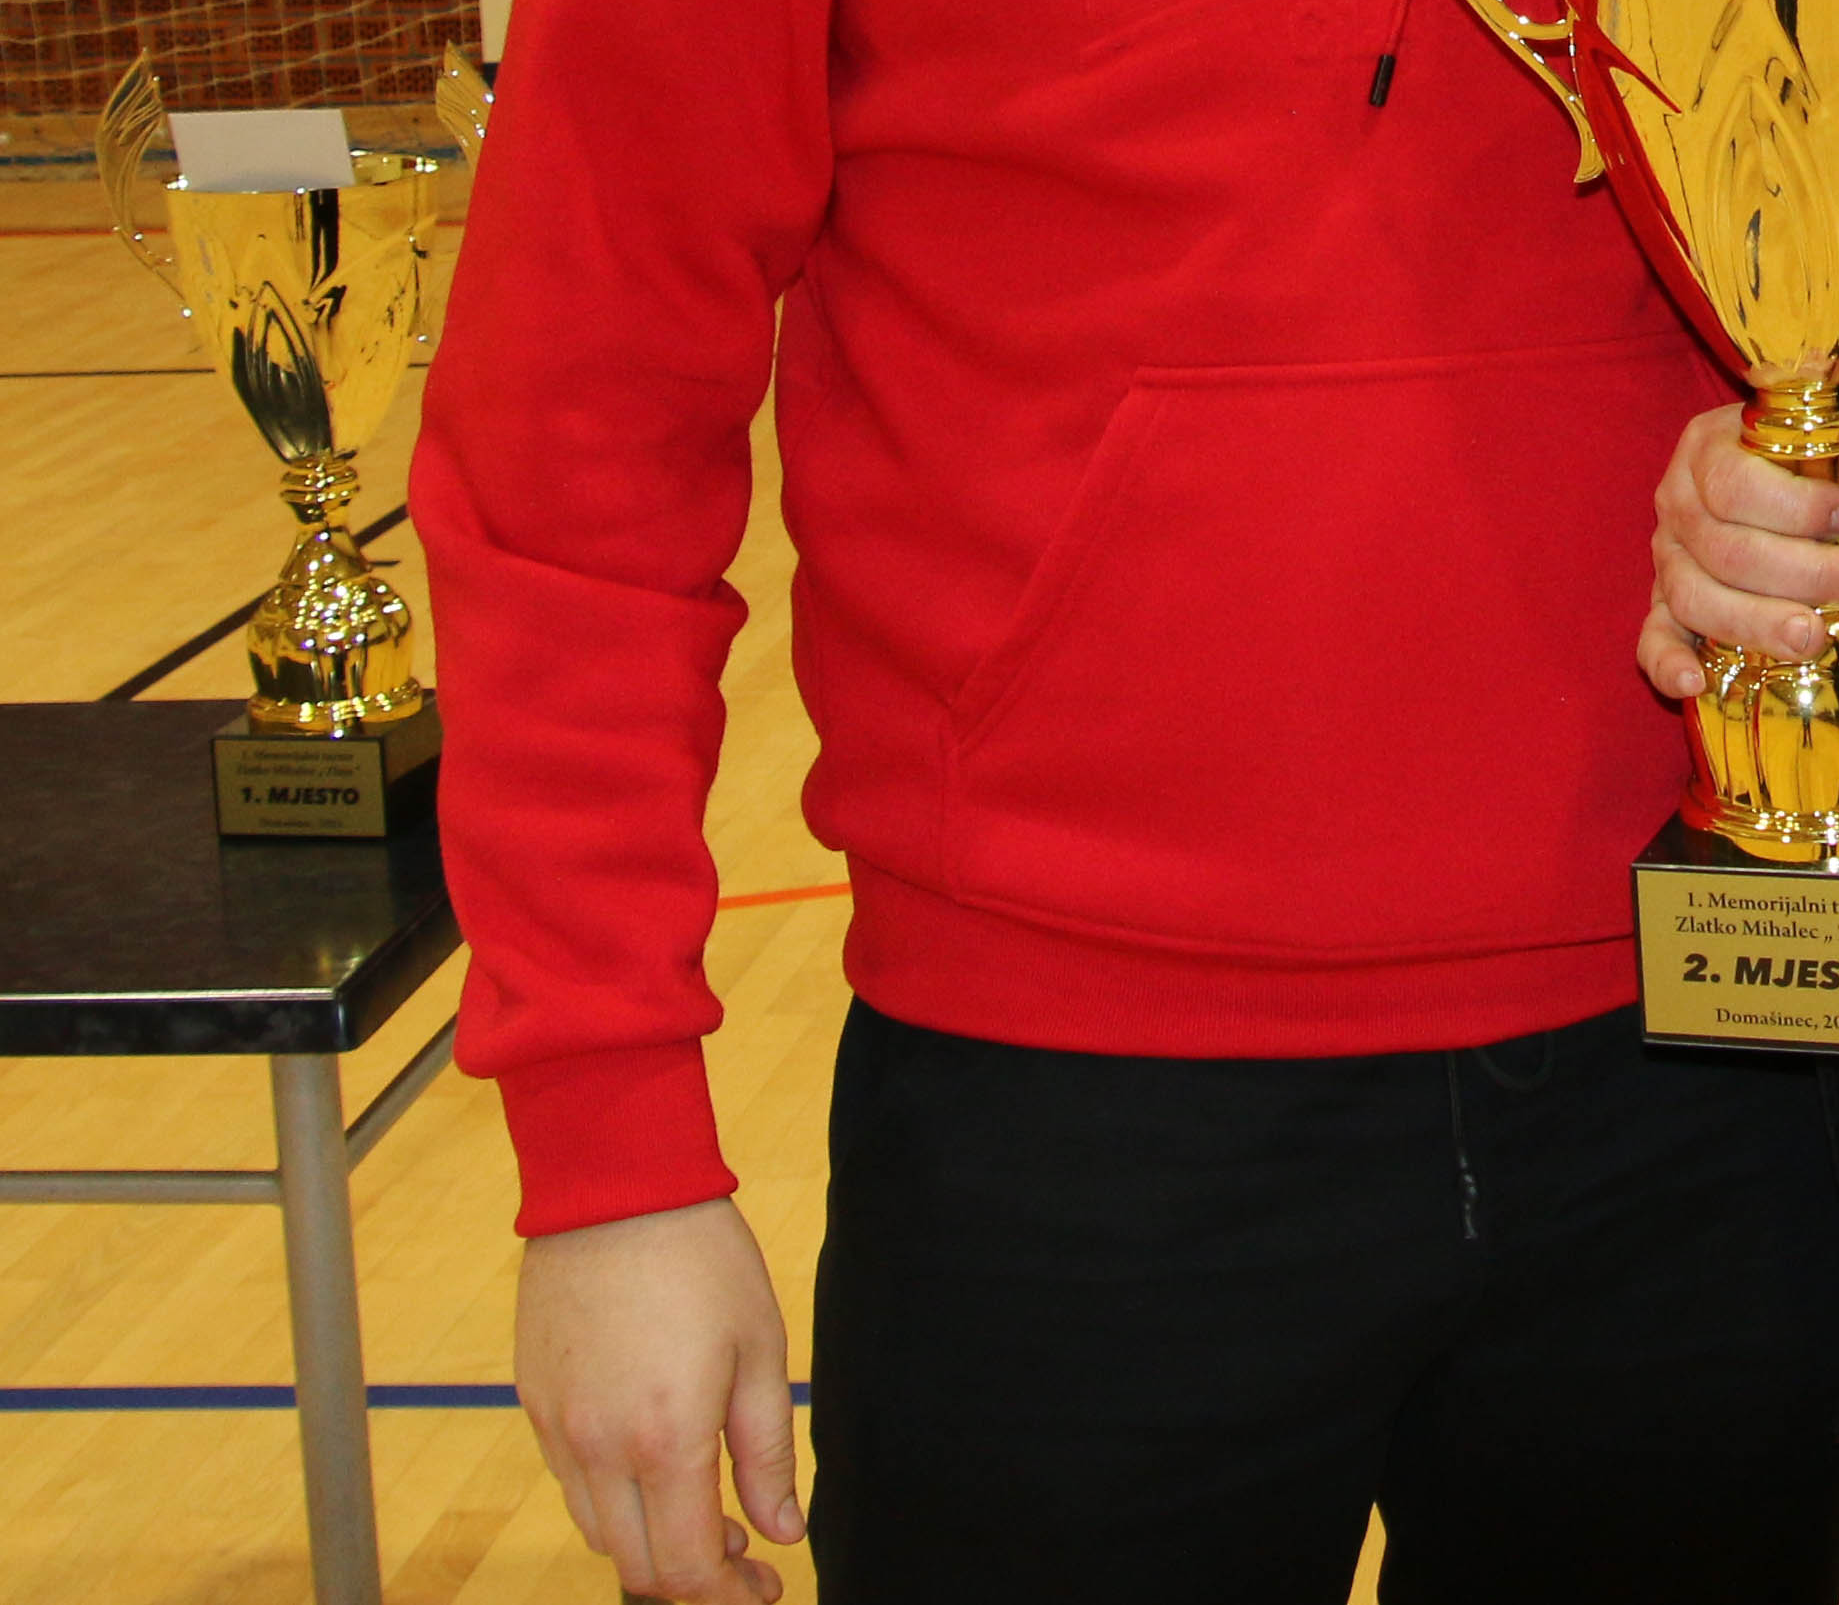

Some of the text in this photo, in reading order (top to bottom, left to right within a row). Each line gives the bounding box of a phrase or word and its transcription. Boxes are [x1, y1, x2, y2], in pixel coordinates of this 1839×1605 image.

[240, 786, 361, 805] 1. MJESTO
[1687, 891, 1703, 908] 1.
[1708, 891, 1827, 918] Memorijalni
[1674, 915, 1738, 936] Zlatko
[1741, 919, 1820, 940] Mihalec
[1682, 952, 1721, 984] 2.
[1714, 1007, 1819, 1031] Domašinec,
